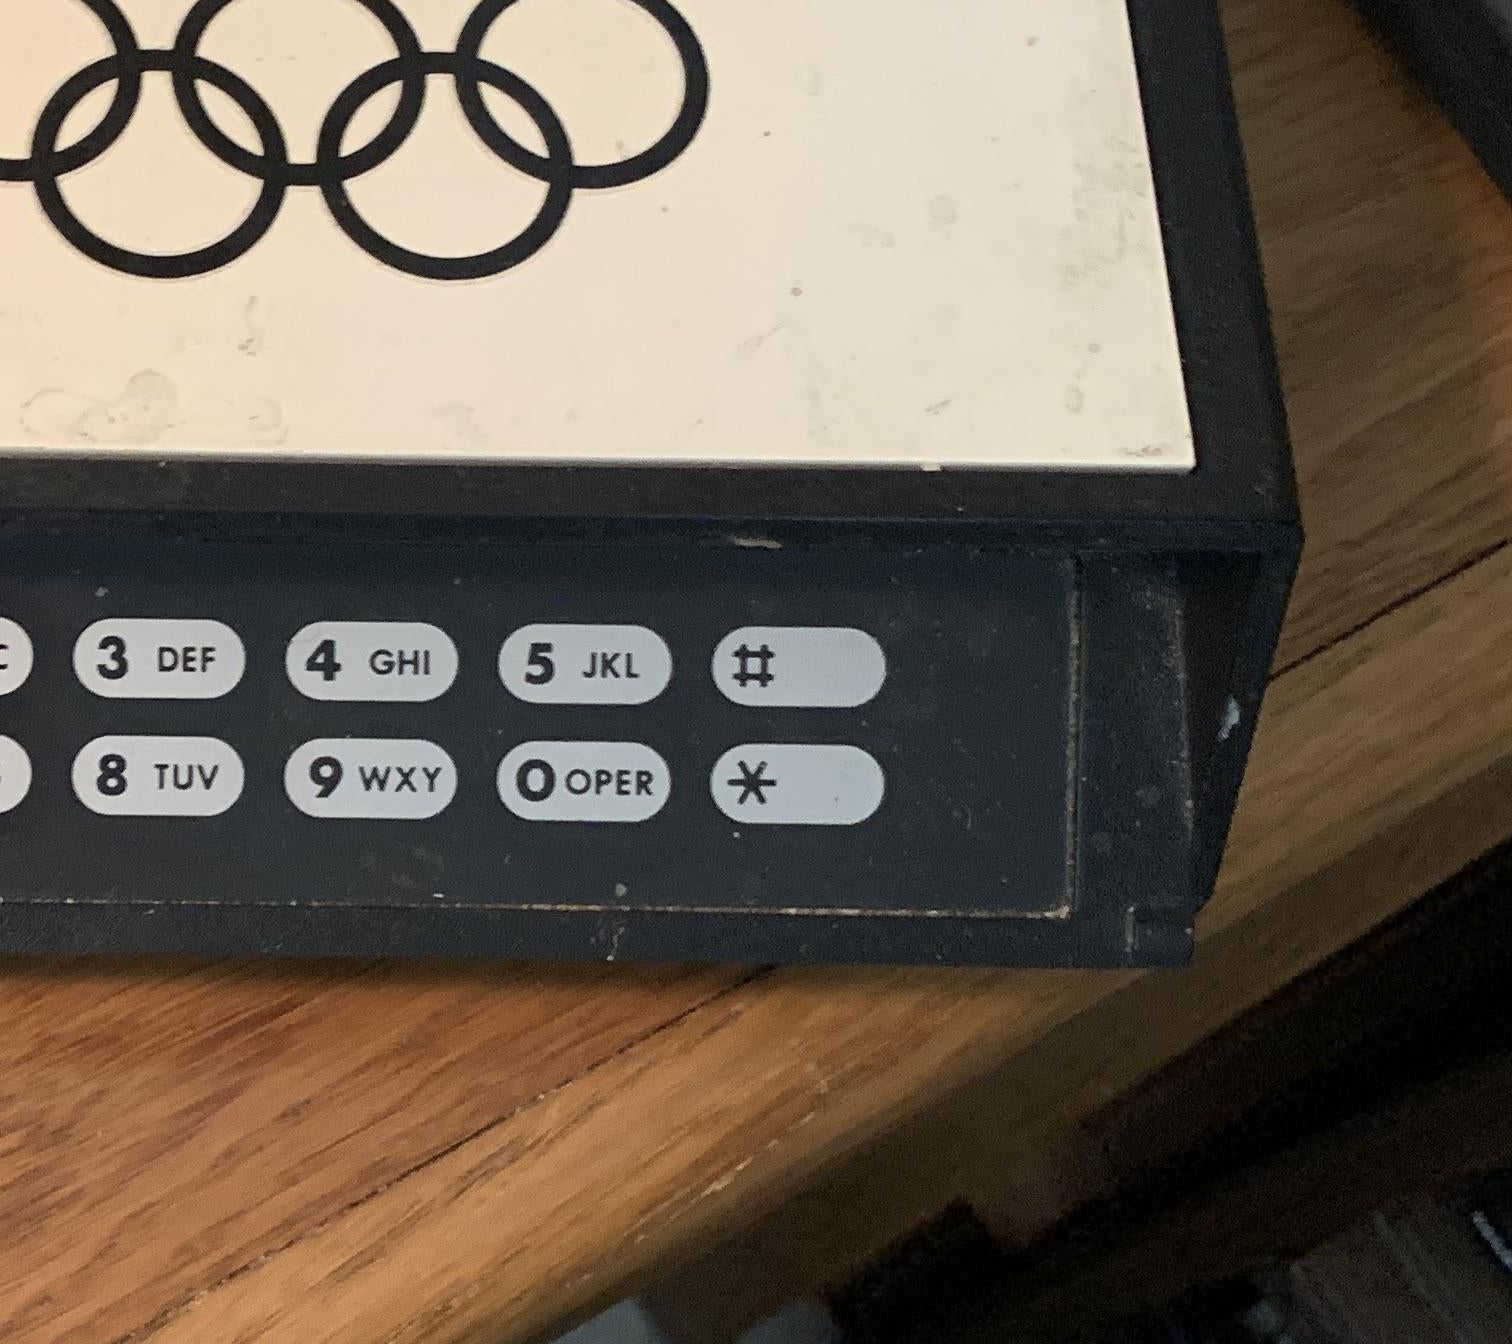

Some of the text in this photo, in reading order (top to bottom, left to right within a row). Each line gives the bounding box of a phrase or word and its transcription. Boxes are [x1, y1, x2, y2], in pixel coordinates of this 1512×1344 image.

[96, 635, 217, 681] 3 DEF
[305, 638, 431, 682] 4 GHI
[524, 642, 640, 686] 5 JKL
[95, 753, 219, 797] 8 TUV
[308, 755, 443, 799] 9 WXY
[515, 758, 654, 803] 0 OPER
